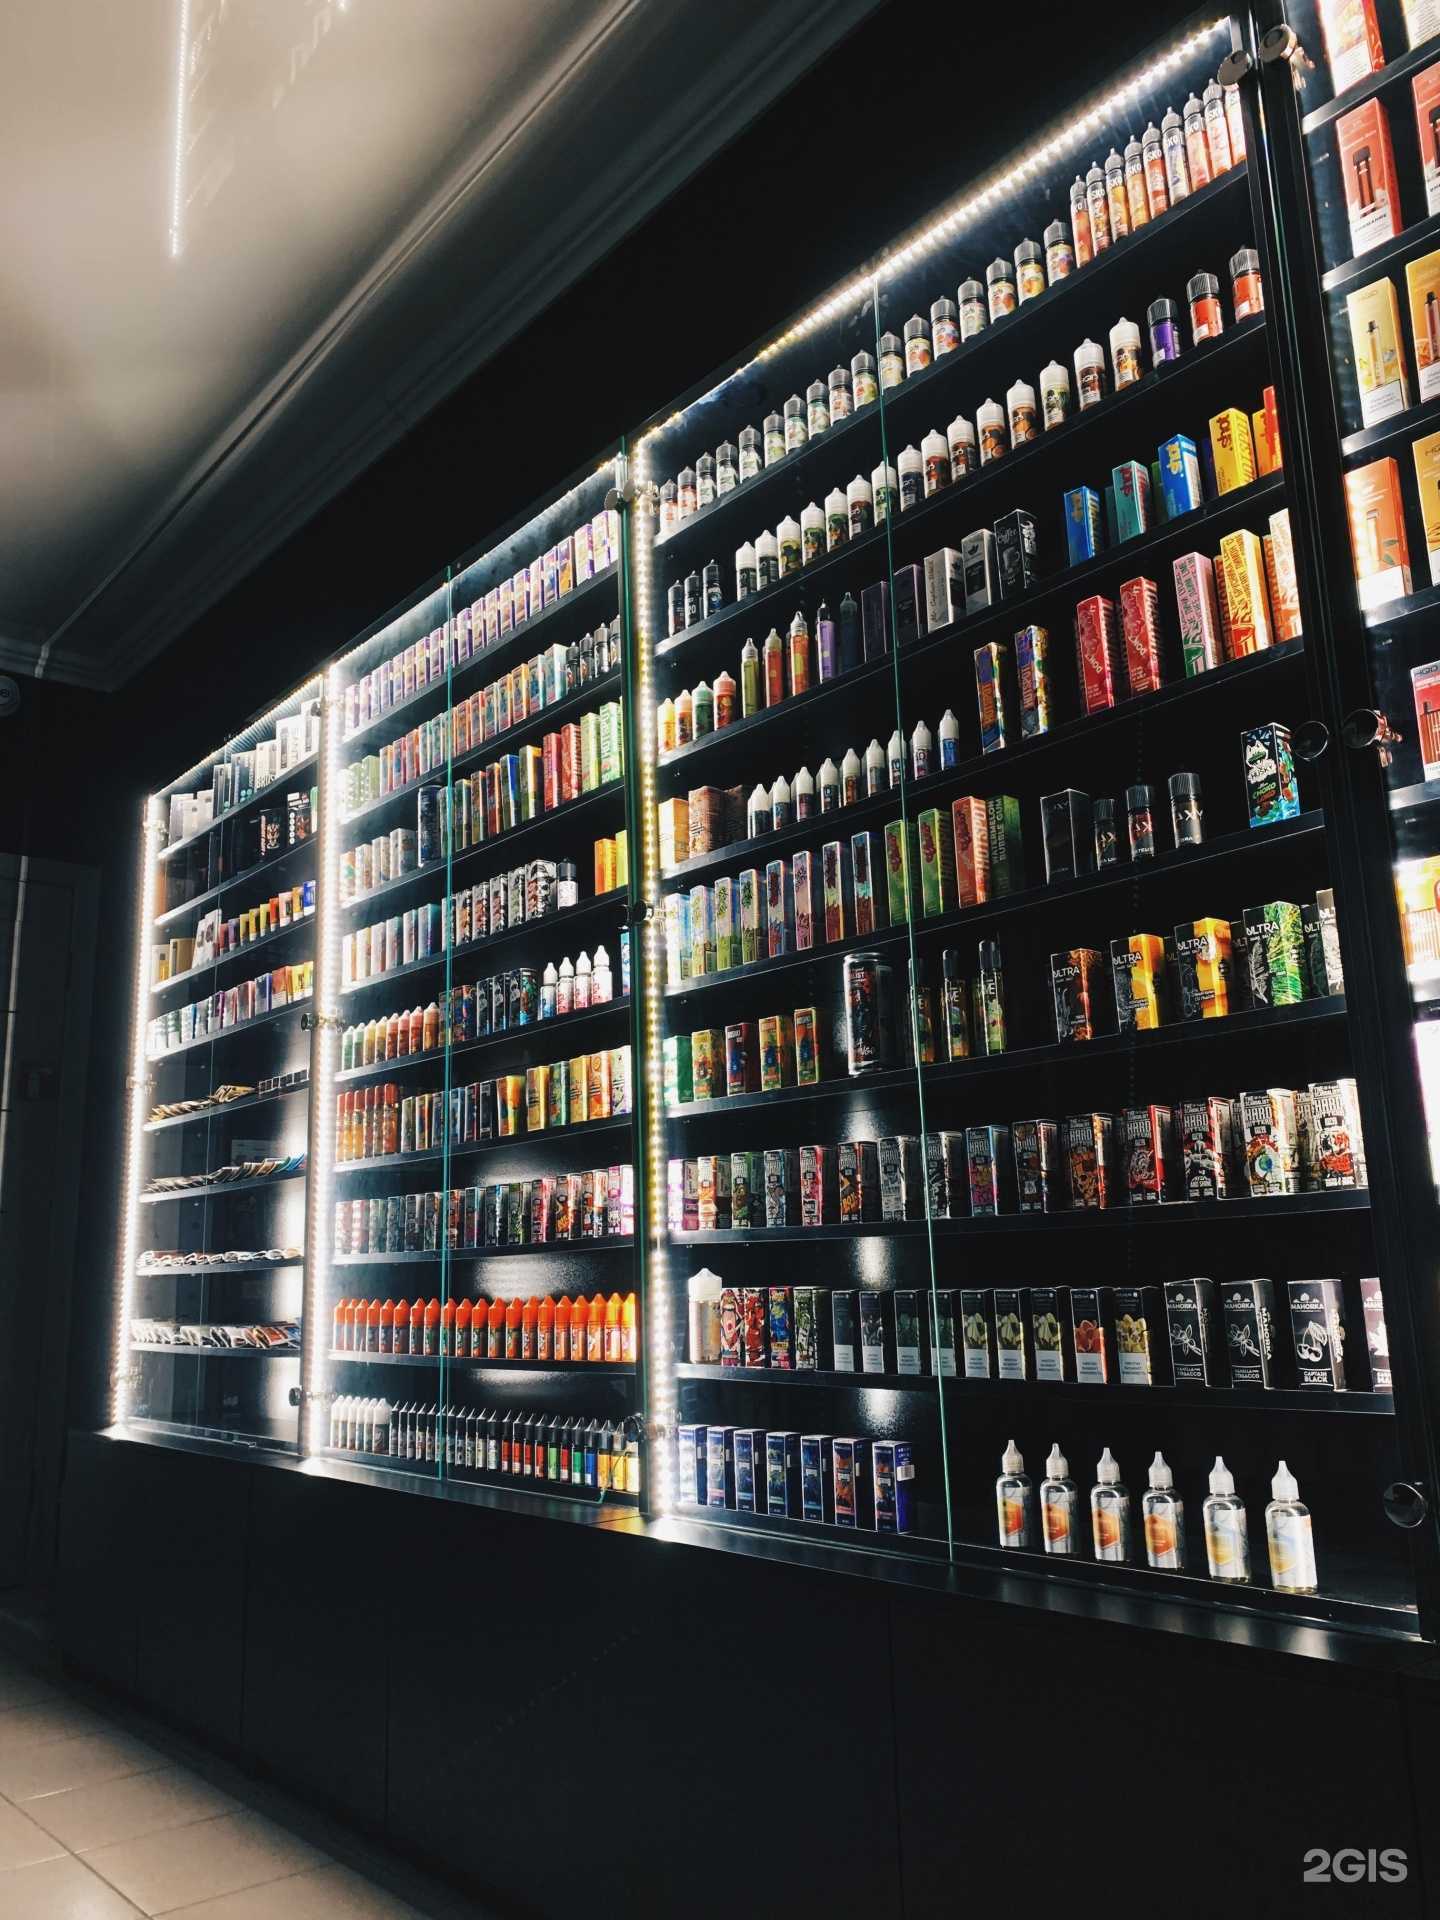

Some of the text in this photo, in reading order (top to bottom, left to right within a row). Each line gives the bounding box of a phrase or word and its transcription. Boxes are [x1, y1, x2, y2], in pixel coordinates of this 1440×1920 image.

[996, 798, 1004, 822] GUM
[989, 800, 999, 864] WATERMELON
[1246, 922, 1279, 936] ULTRA
[1177, 937, 1208, 951] ULTRA
[1112, 951, 1142, 966] ULTRA
[1053, 966, 1080, 978] ULTRA
[1245, 1107, 1272, 1121] HARD
